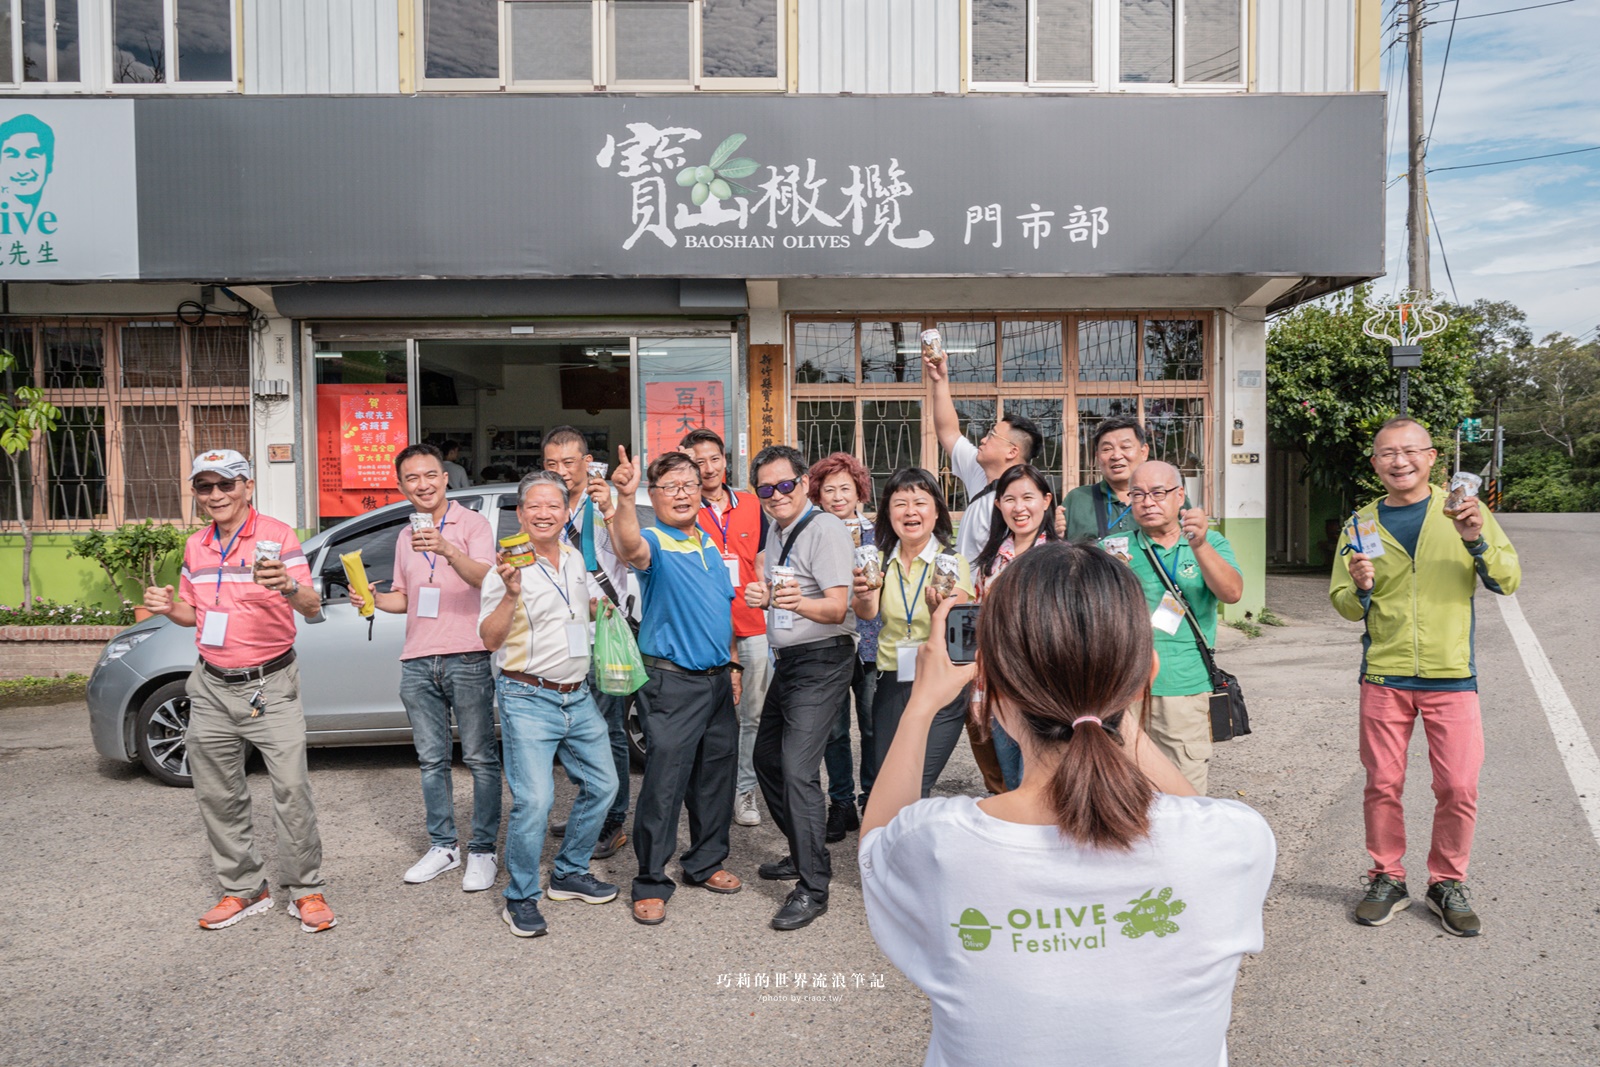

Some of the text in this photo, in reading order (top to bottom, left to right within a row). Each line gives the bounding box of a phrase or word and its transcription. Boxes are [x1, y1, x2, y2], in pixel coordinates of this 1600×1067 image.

[596, 122, 935, 250] 寶山橄欖
[963, 203, 1109, 250] 門市部
[0, 240, 58, 266] 先生
[684, 235, 851, 249] BAOSHAN OLIVES
[675, 387, 697, 434] 百大
[1007, 903, 1107, 930] OLIVE
[1011, 926, 1106, 953] Festival
